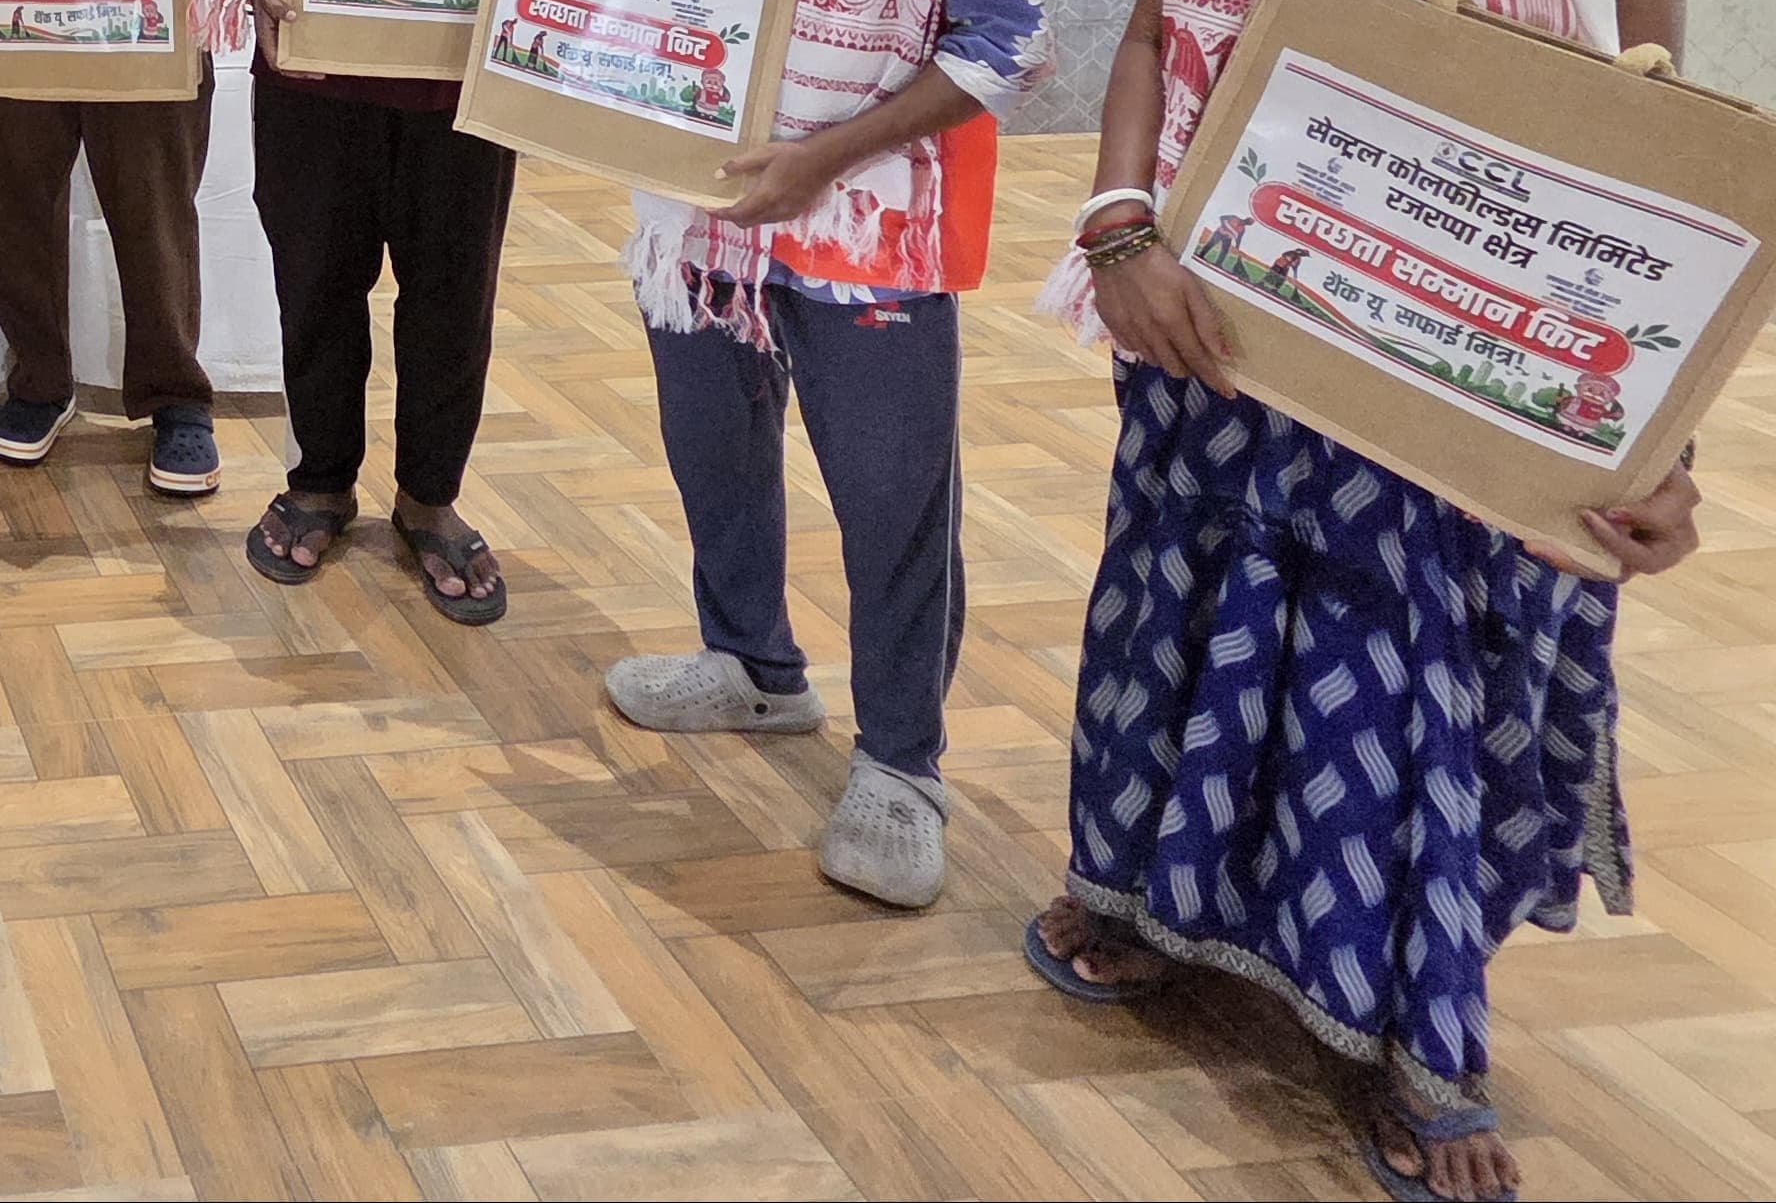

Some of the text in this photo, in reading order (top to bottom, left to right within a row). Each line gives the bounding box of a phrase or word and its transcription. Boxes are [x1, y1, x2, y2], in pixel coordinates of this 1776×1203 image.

[54, 10, 65, 26] यू
[666, 26, 710, 61] किट
[1305, 116, 1387, 167] सेन्ट्रल
[1386, 157, 1544, 240] कोलफील्डस
[1546, 221, 1673, 282] लिमिटेड
[1458, 151, 1531, 195] CCL
[1385, 186, 1538, 269] रजरप्पा क्षेत्र
[1275, 194, 1388, 267] स्वच्छता
[1389, 246, 1526, 331] सम्मान
[1524, 309, 1607, 362] किट
[1365, 292, 1386, 322] यू
[1394, 301, 1465, 348] सफाई
